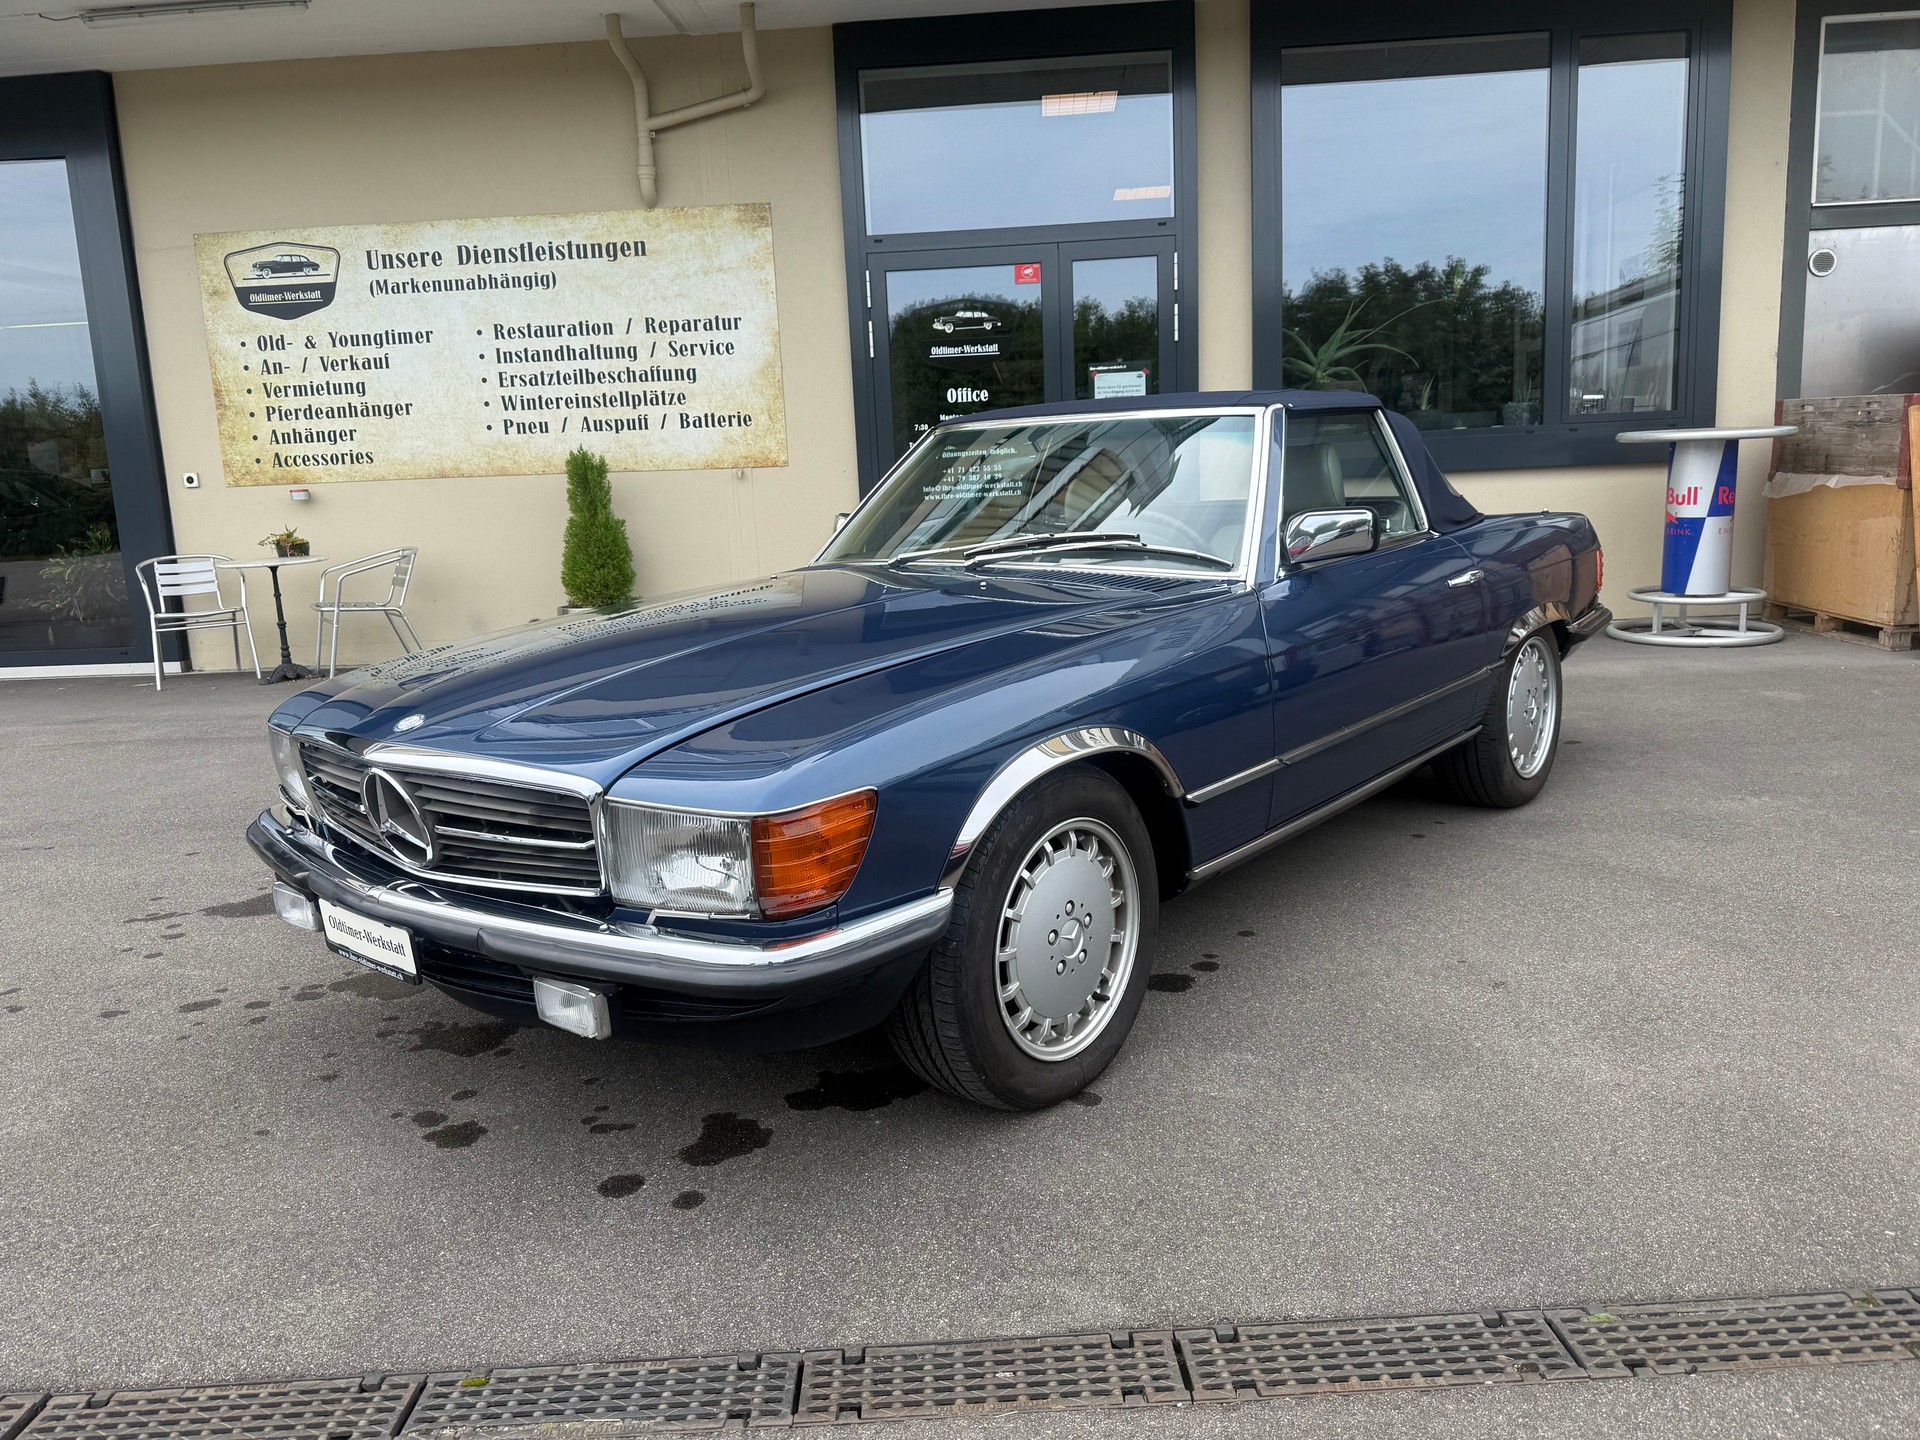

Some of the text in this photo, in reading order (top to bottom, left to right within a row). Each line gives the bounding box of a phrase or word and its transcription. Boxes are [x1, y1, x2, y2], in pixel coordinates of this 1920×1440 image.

[365, 240, 647, 271] Unsere Dienstleistungen
[369, 270, 557, 299] (Markenunabhängig)
[249, 290, 321, 303] Oldtimer-Werkstatt
[493, 314, 742, 340] Restauration / Reparatur
[257, 329, 434, 352] Old- & Youngtimer
[495, 339, 735, 364] Instandhaltung / Service
[931, 344, 998, 355] Oldtimer-Werkstatt
[260, 353, 391, 376] An- / Verkauf
[498, 365, 697, 388] Ersatzteilbeschaffung
[262, 380, 367, 399] Vermietung
[501, 389, 687, 412] Wintereinstellplätze
[947, 388, 989, 403] Office
[265, 402, 413, 422] Pferdeanhänger
[503, 411, 753, 436] Pneu / Auspuff / Batterie
[269, 428, 358, 446] Anhänger
[272, 450, 374, 469] Accessories
[1667, 486, 1698, 506] Bull
[1718, 486, 1735, 505] Re
[328, 914, 407, 957] Oldtimer-Werkstatt
